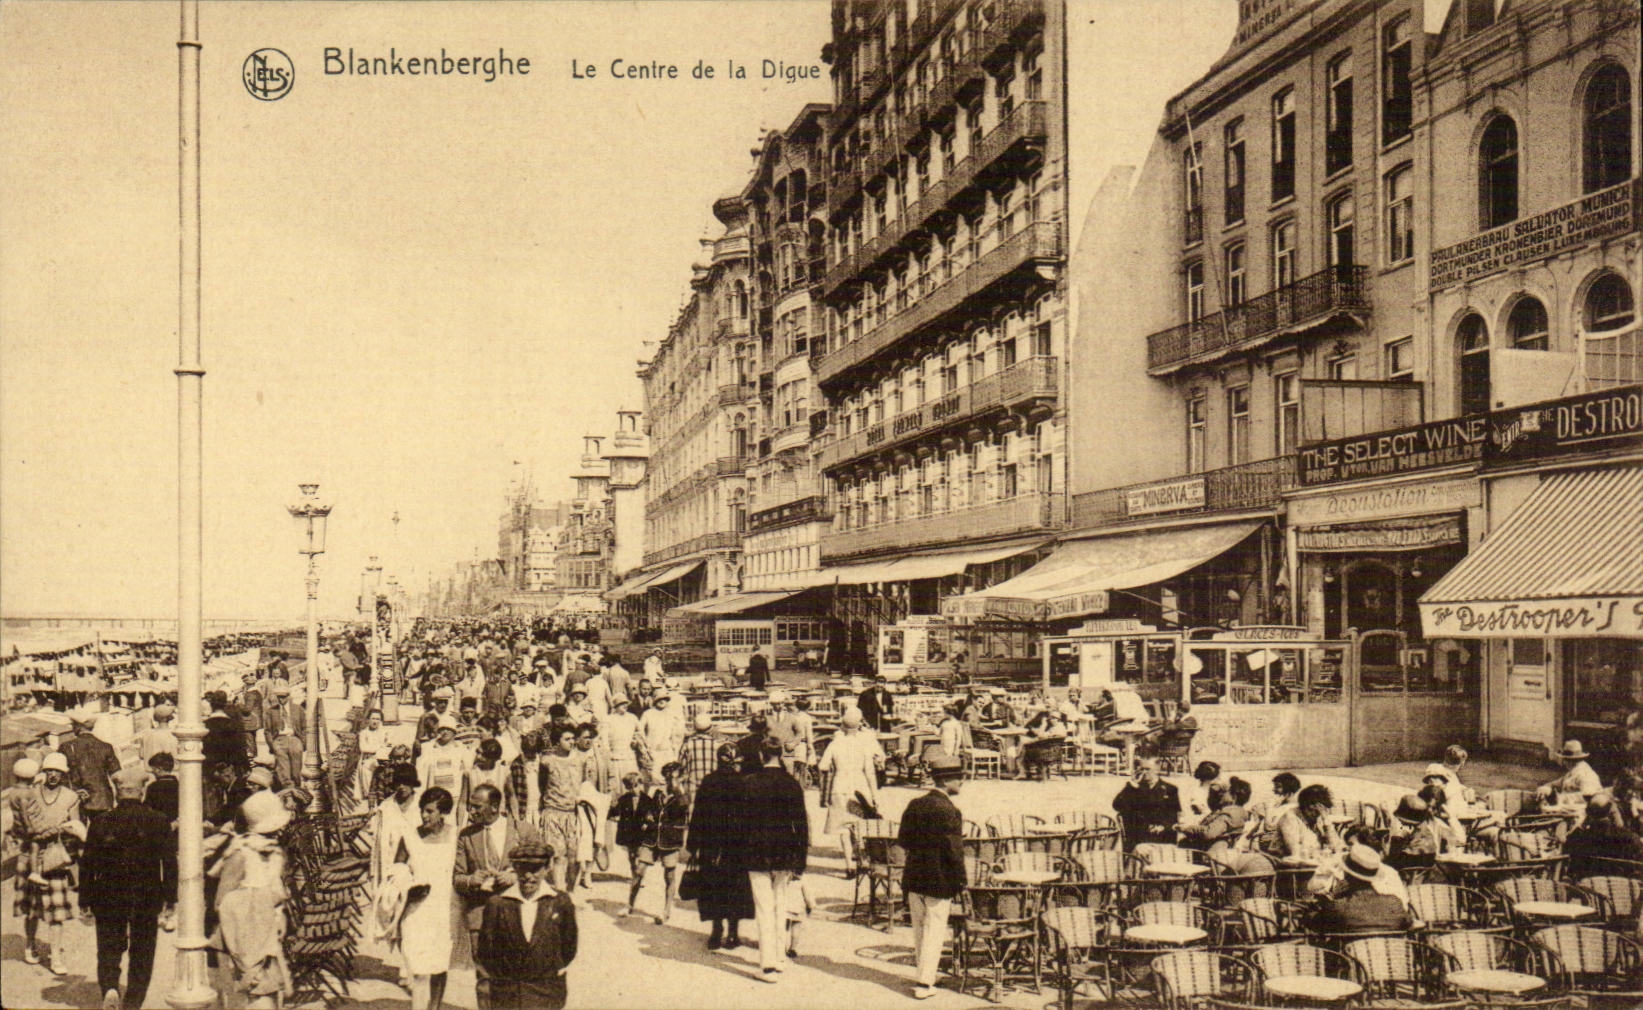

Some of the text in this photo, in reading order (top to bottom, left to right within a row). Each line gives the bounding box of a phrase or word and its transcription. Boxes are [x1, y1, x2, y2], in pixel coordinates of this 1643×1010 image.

[1431, 248, 1491, 276] DORTMUNDER
[1567, 202, 1630, 233] DORTMUND
[1431, 269, 1463, 288] DOUBLE
[1466, 259, 1500, 277] PILSEN
[1503, 241, 1550, 265] CLAUSEN
[1557, 394, 1643, 439] DESTRO
[1302, 446, 1339, 469] THE
[1344, 431, 1418, 464] SELECT
[1424, 418, 1487, 449] WINE
[1143, 484, 1187, 507] MINERVA
[1432, 606, 1453, 626] The
